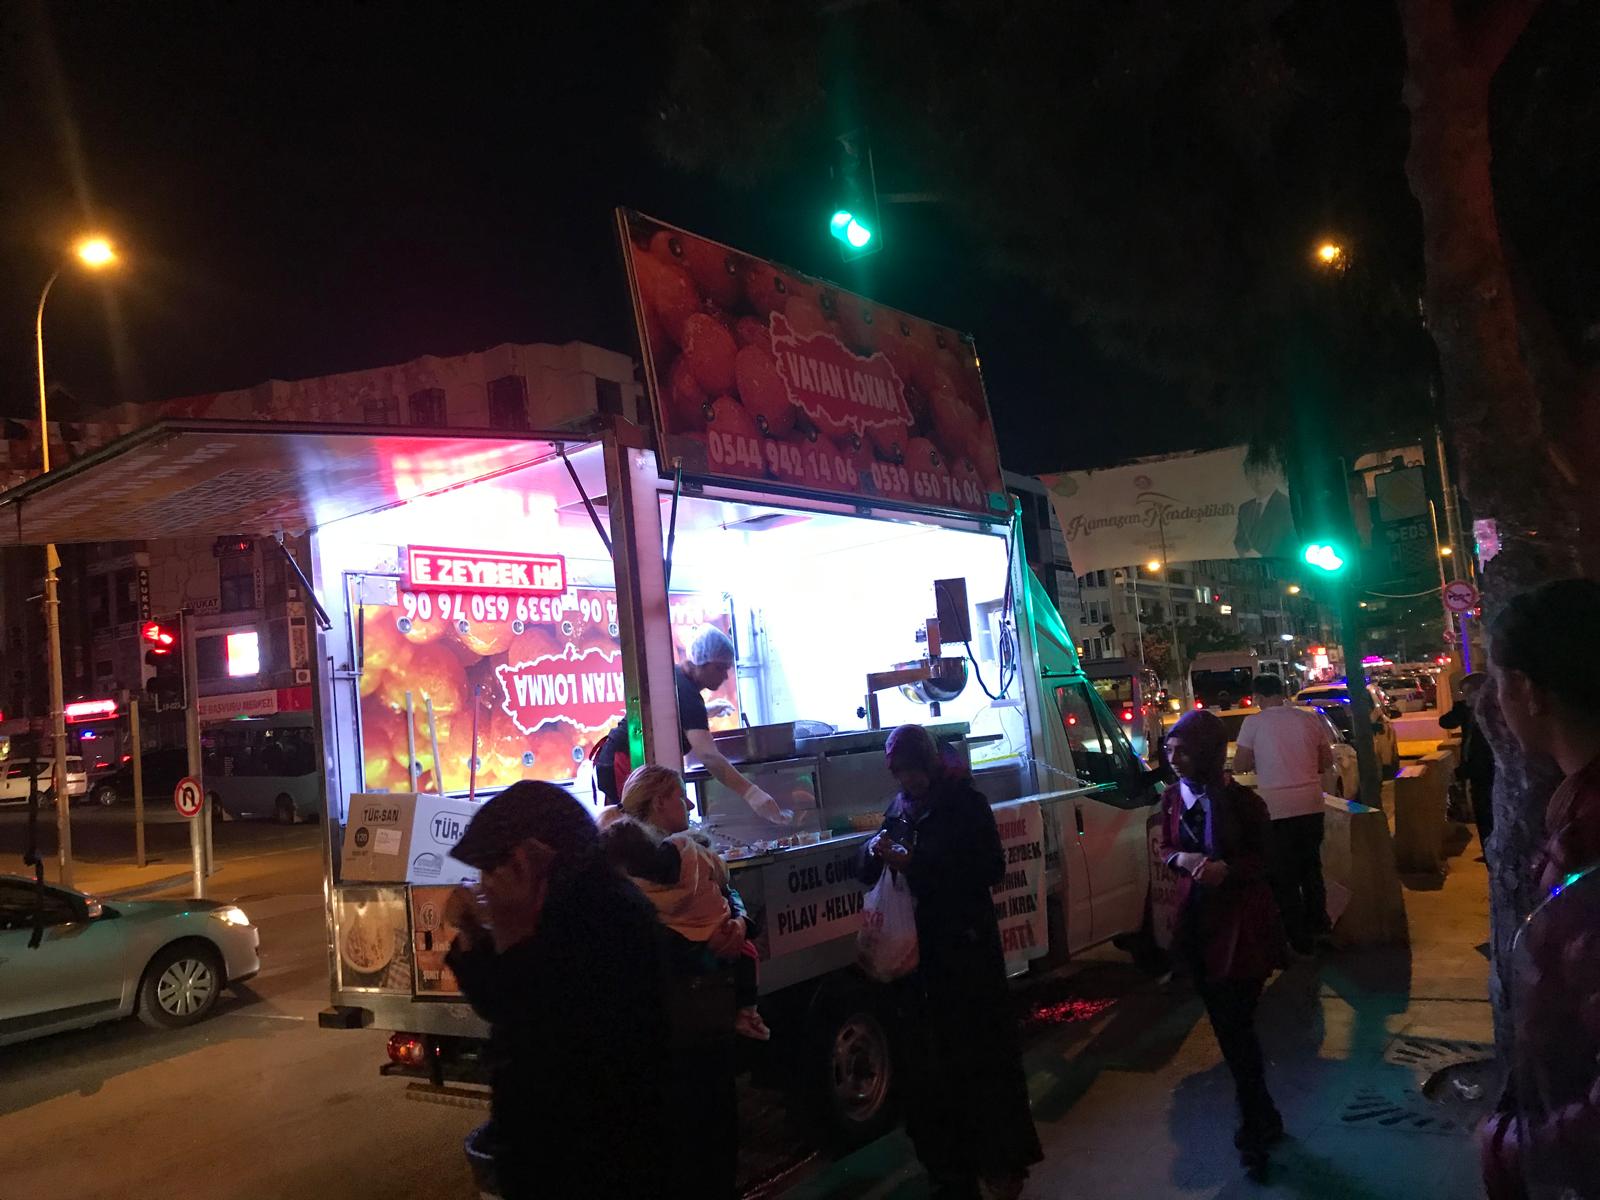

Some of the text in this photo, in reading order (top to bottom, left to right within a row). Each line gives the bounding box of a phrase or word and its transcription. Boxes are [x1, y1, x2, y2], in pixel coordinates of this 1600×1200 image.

[785, 351, 900, 414] VATAN LOKMA
[708, 430, 983, 505] 0544 942 14 06 0539 650 76 06
[1066, 512, 1142, 543] Ramazan
[436, 559, 530, 587] ZEYBEK
[139, 570, 150, 619] AVUKAT
[402, 591, 432, 621] 06
[437, 593, 466, 621] 76
[471, 594, 509, 622] 650
[516, 595, 564, 623] 0539
[580, 596, 602, 623] 06
[513, 671, 625, 708] ATAN LOKMA
[788, 865, 822, 894] ÖZEL
[778, 903, 818, 936] PİLAV
